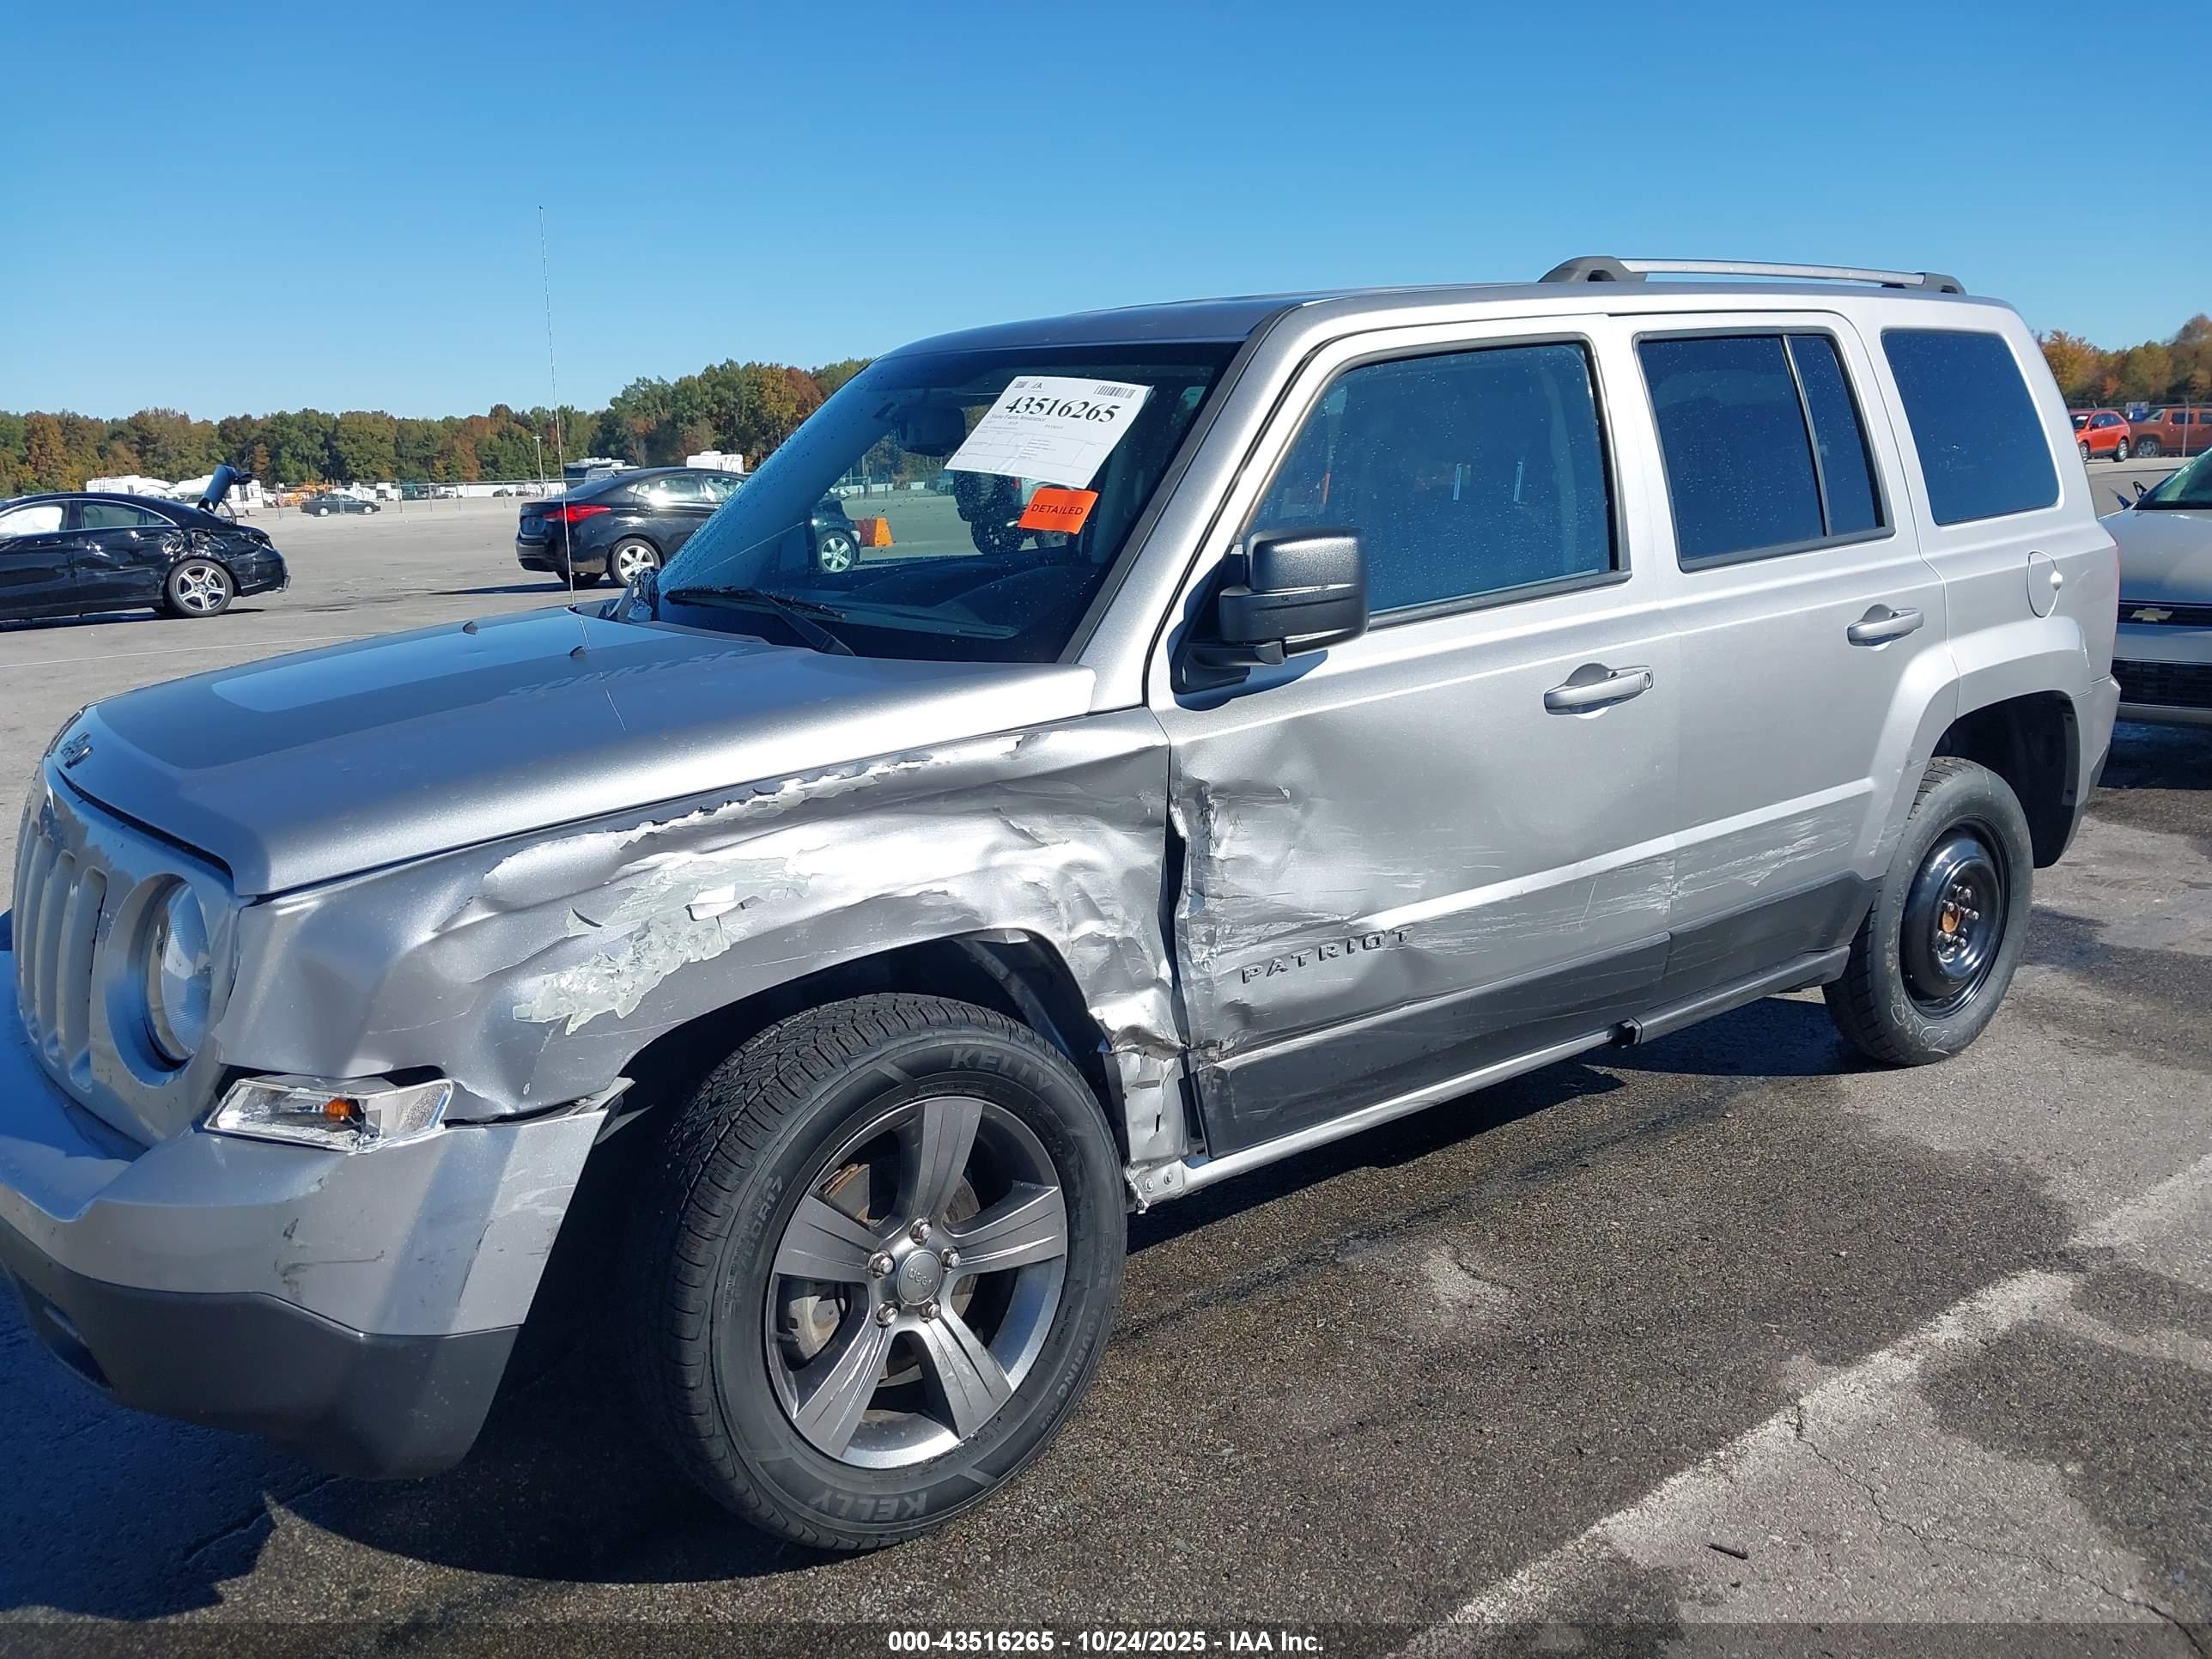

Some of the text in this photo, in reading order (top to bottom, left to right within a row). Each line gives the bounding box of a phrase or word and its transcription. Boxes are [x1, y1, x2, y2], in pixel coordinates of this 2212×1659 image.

[1005, 396, 1121, 422] 43516265
[1030, 502, 1085, 516] DETAILED
[1241, 925, 1415, 984] PATRIOT
[950, 1048, 1054, 1092] KELLY
[808, 1489, 927, 1521] KELLY
